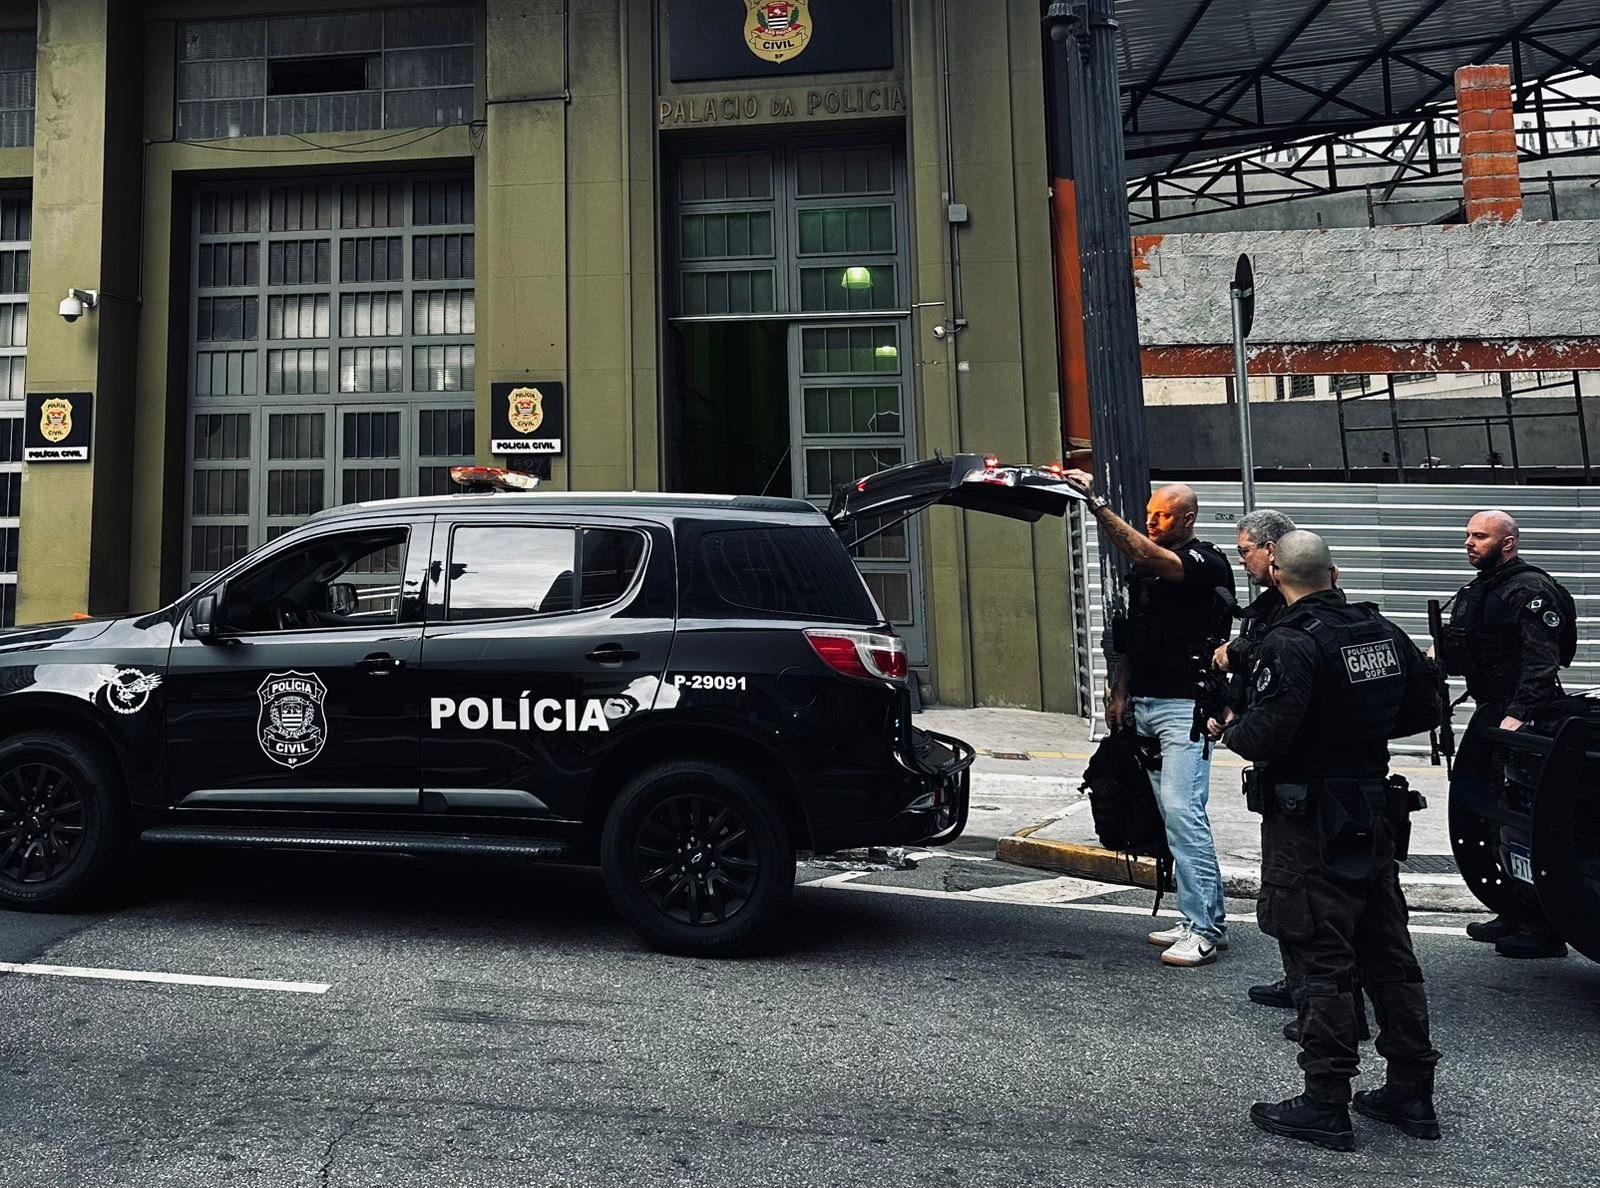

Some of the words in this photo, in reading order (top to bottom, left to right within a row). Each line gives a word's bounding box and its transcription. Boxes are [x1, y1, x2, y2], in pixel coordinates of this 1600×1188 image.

[763, 40, 795, 50] CIVIL
[659, 96, 758, 124] PALACIO
[770, 98, 794, 117] DA
[807, 86, 906, 116] POLICIA
[532, 442, 555, 450] CIVIL
[1375, 643, 1390, 652] CIVIL
[1347, 650, 1397, 673] GARRA
[1364, 667, 1387, 678] DOPE
[271, 679, 312, 694] POLÍCIA
[673, 675, 746, 691] P-29091
[430, 690, 610, 732] POLÍCIA
[289, 728, 307, 737] PAULO
[275, 742, 309, 754] CIVIL
